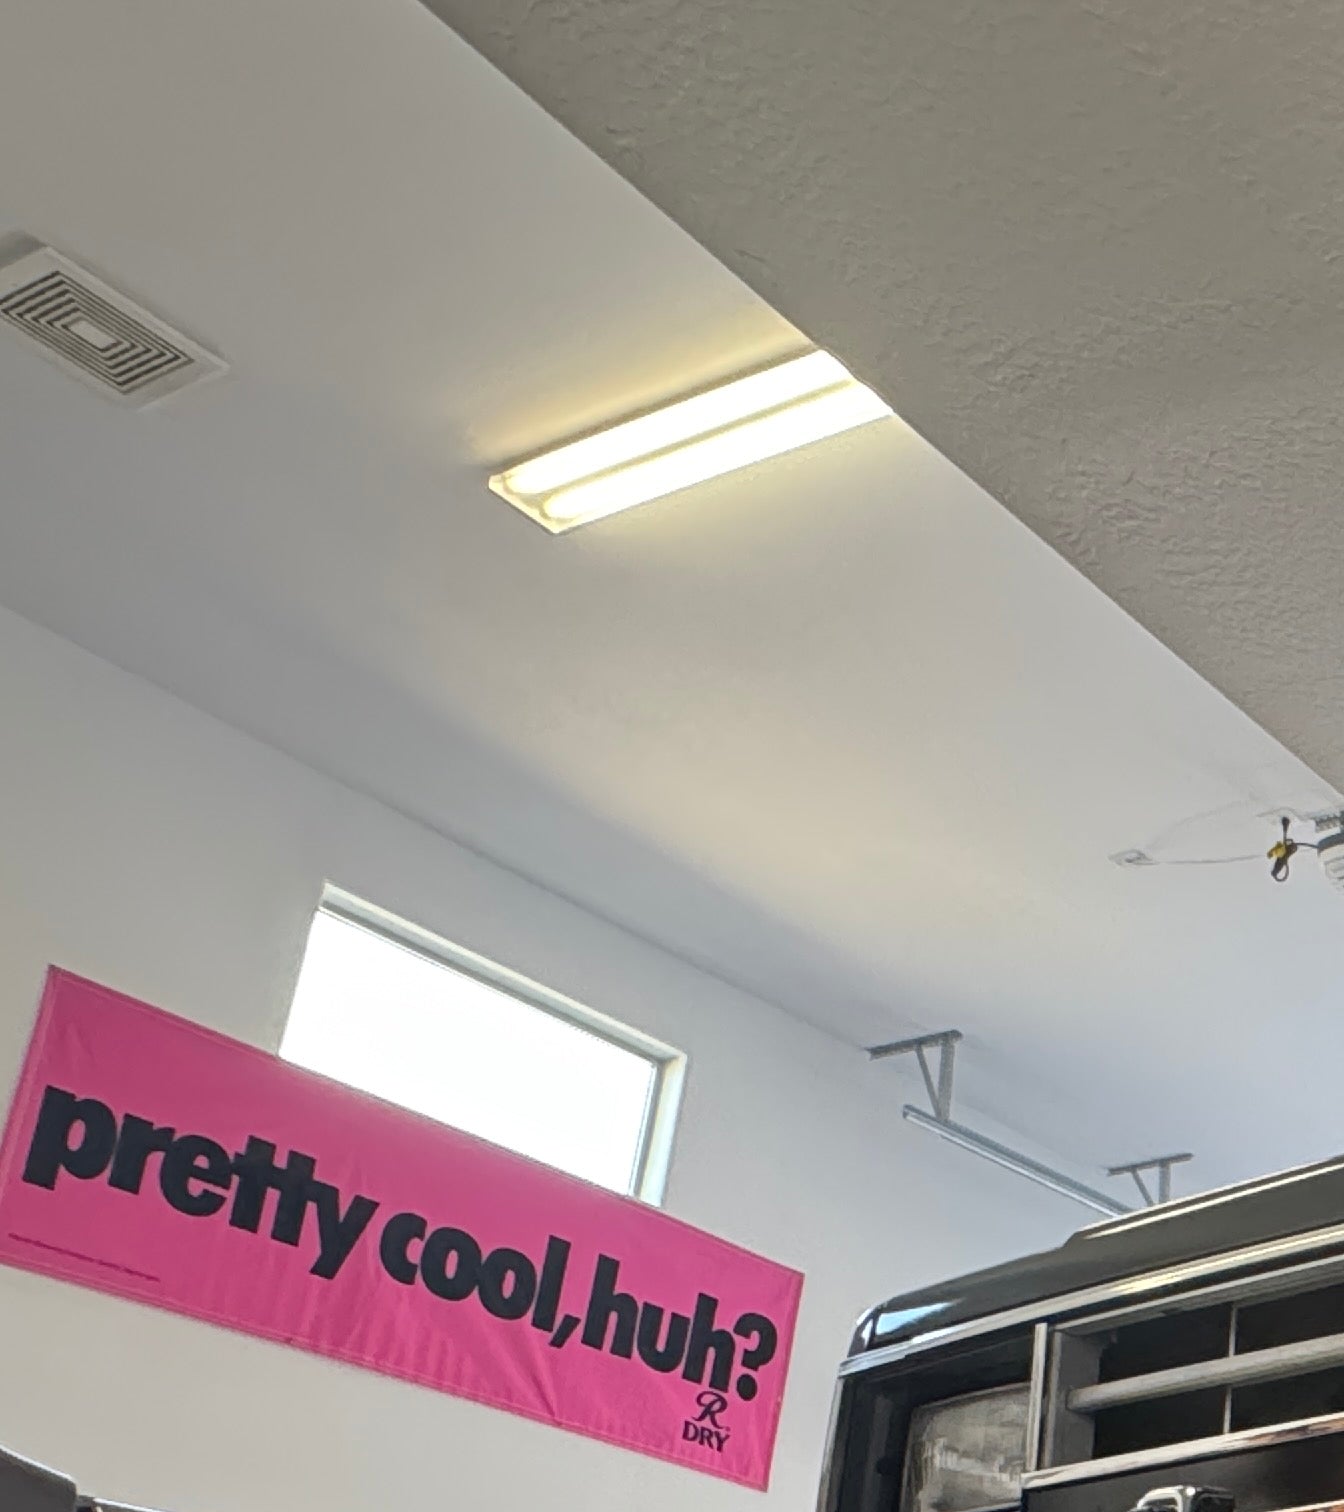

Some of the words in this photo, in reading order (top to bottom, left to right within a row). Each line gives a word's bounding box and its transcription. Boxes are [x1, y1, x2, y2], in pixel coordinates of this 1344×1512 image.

[22, 1085, 379, 1280] pretty
[582, 1254, 777, 1402] huh?
[682, 1420, 731, 1453] DRY
